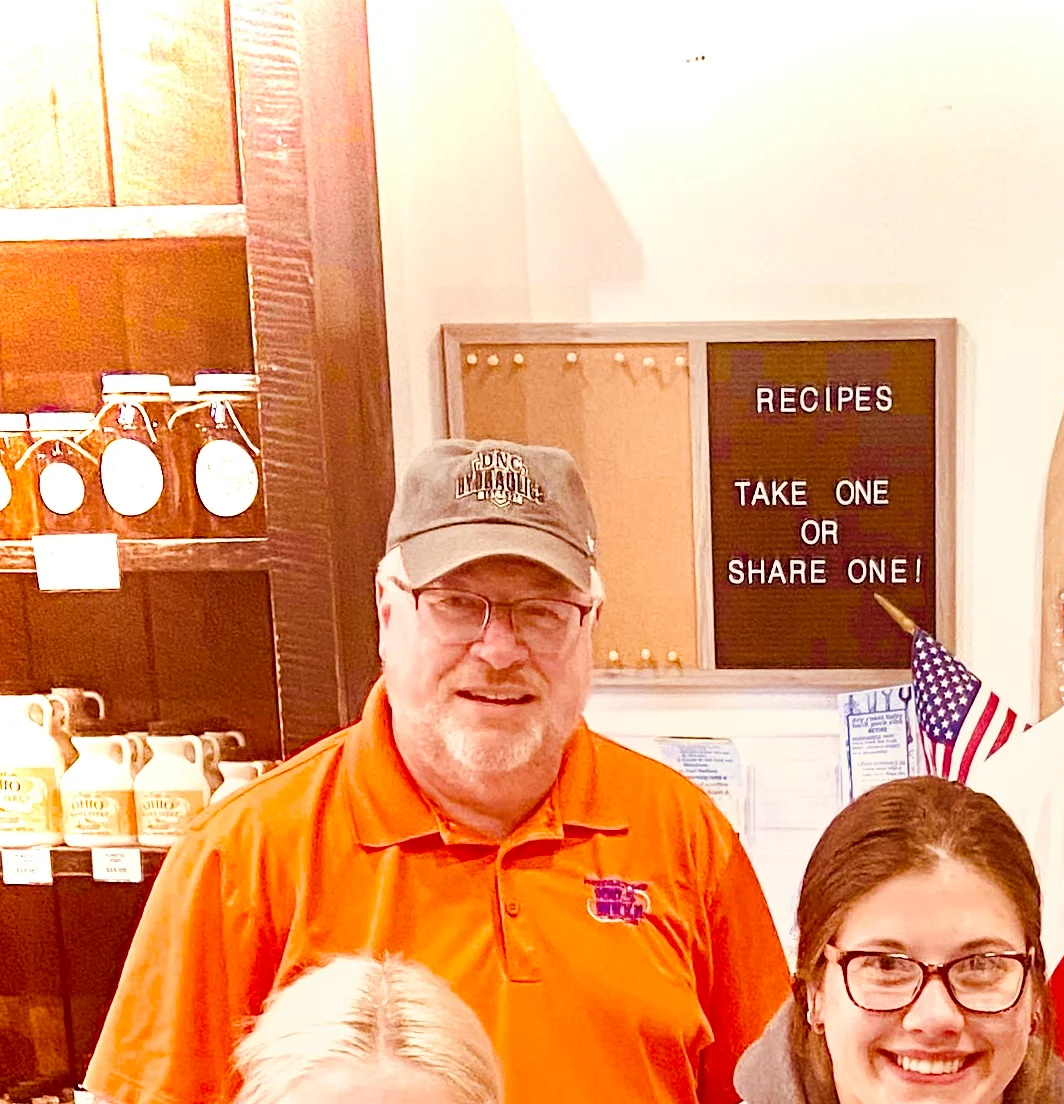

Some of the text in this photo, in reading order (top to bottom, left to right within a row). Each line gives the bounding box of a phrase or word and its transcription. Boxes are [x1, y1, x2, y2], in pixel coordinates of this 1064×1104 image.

[756, 386, 893, 413] RECIPES
[734, 480, 889, 506] TAKE ONE
[801, 519, 839, 545] OR
[728, 557, 922, 585] SHARE ONE!
